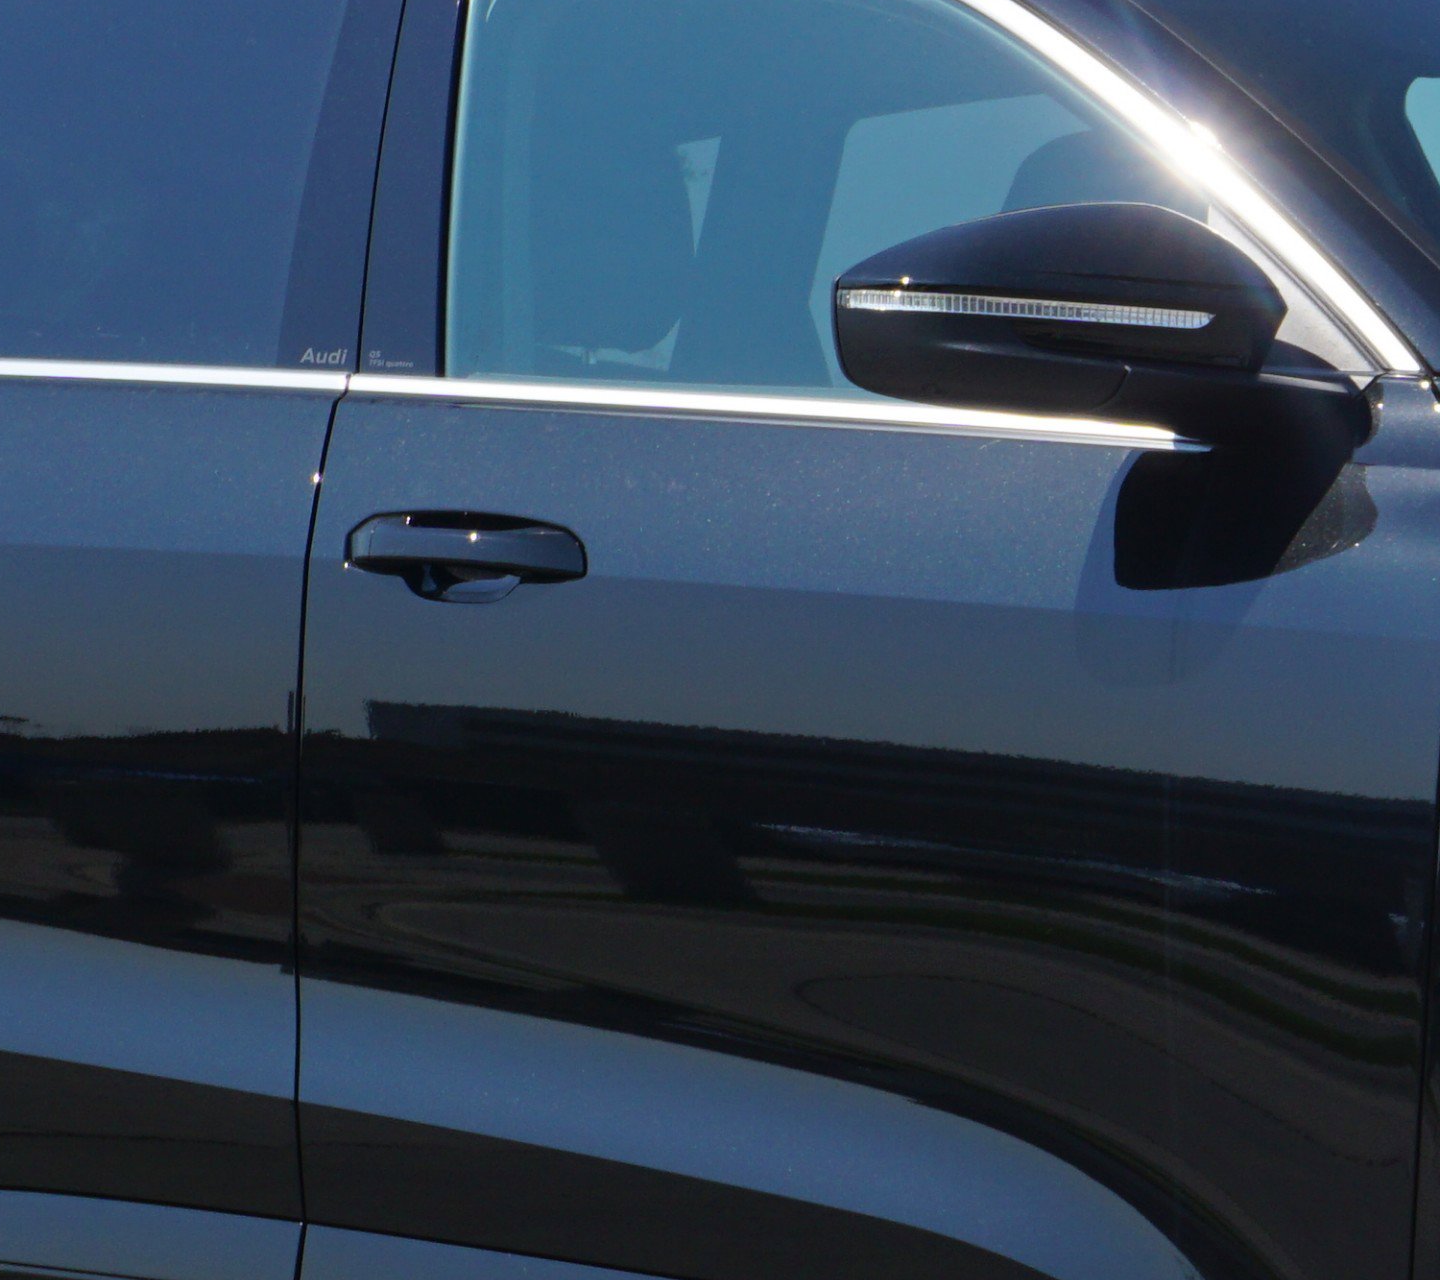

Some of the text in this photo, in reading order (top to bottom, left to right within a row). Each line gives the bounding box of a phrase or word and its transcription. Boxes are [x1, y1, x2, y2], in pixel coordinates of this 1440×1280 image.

[299, 347, 348, 365] Audi
[368, 350, 382, 359] Q5
[385, 360, 414, 368] quattro
